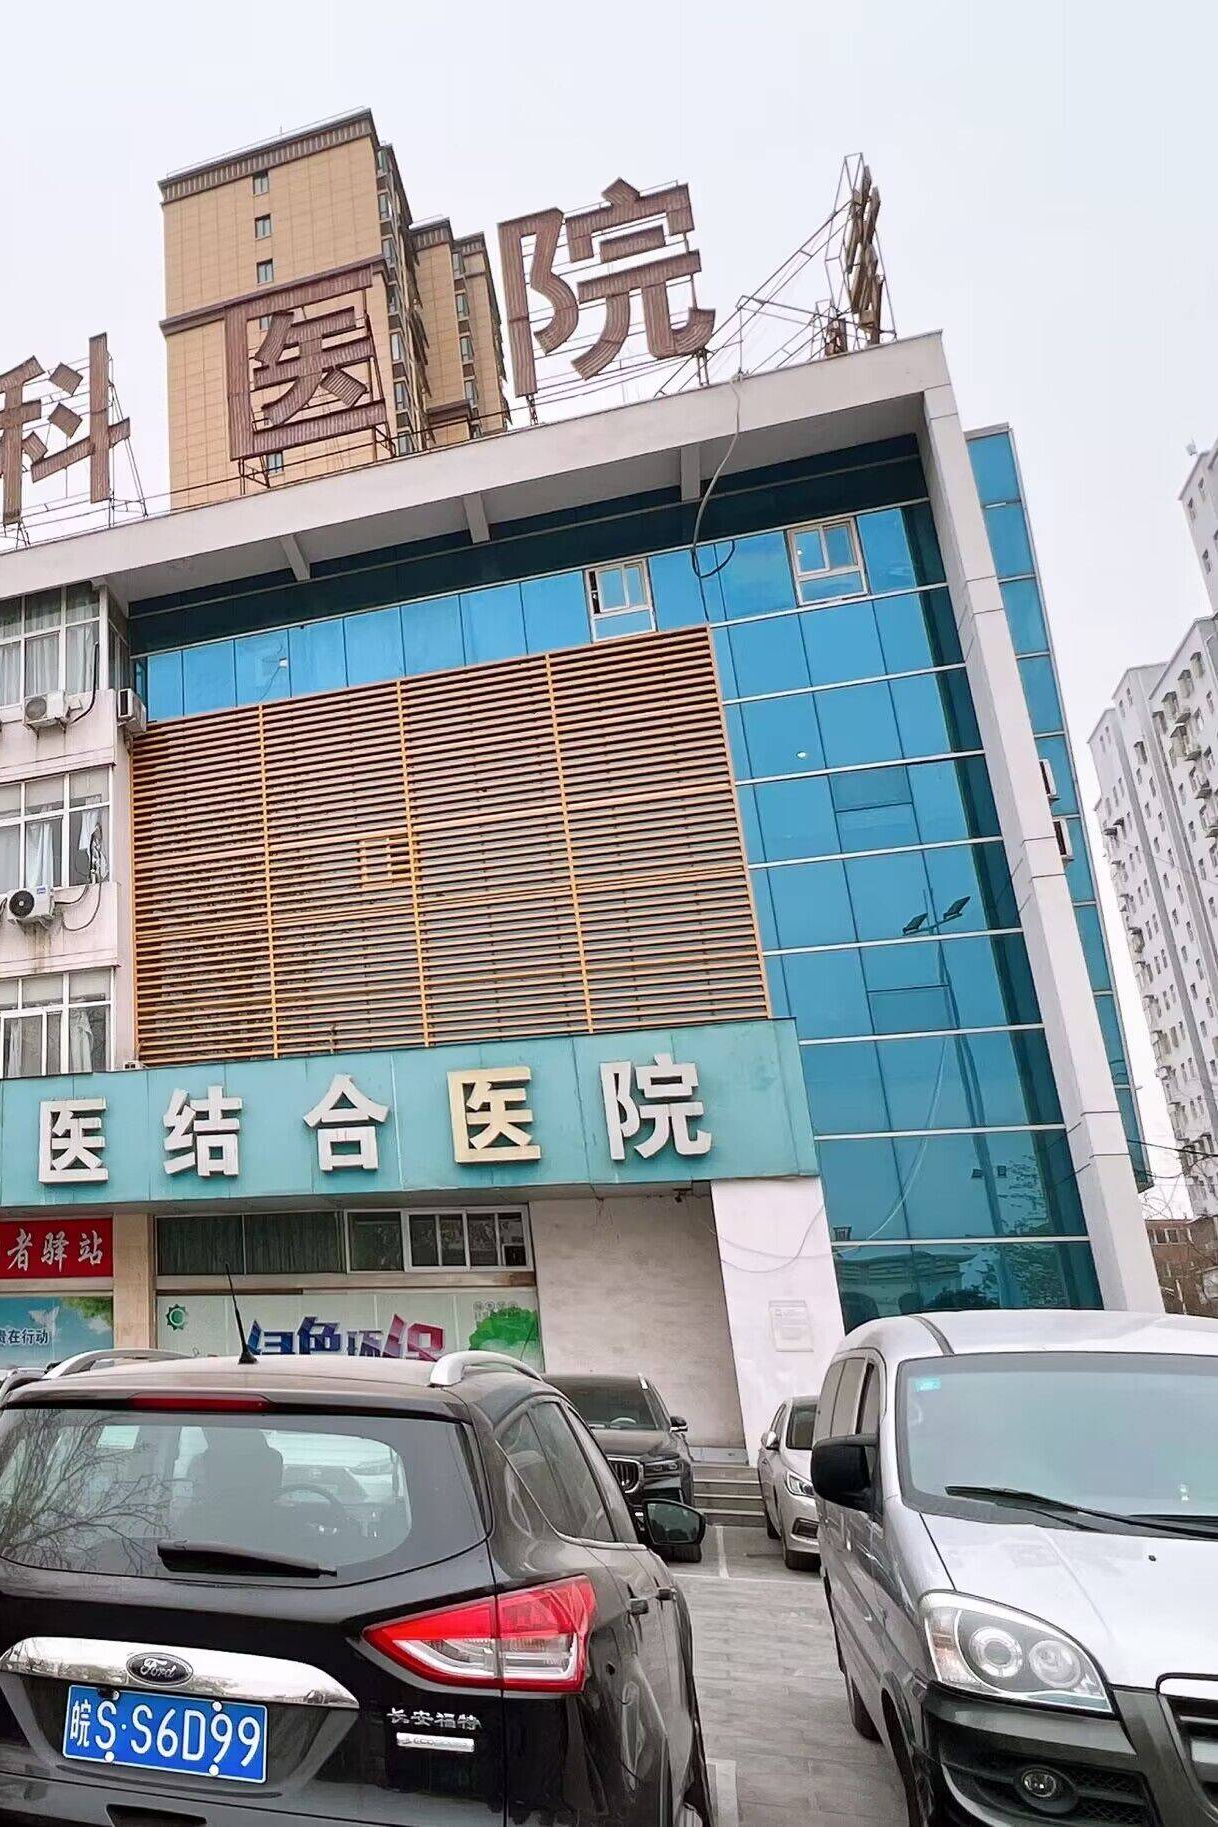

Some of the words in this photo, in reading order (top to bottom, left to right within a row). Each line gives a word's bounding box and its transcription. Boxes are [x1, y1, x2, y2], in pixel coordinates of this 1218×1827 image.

[139, 1657, 178, 1679] Ford
[386, 1706, 483, 1731] 长安福特
